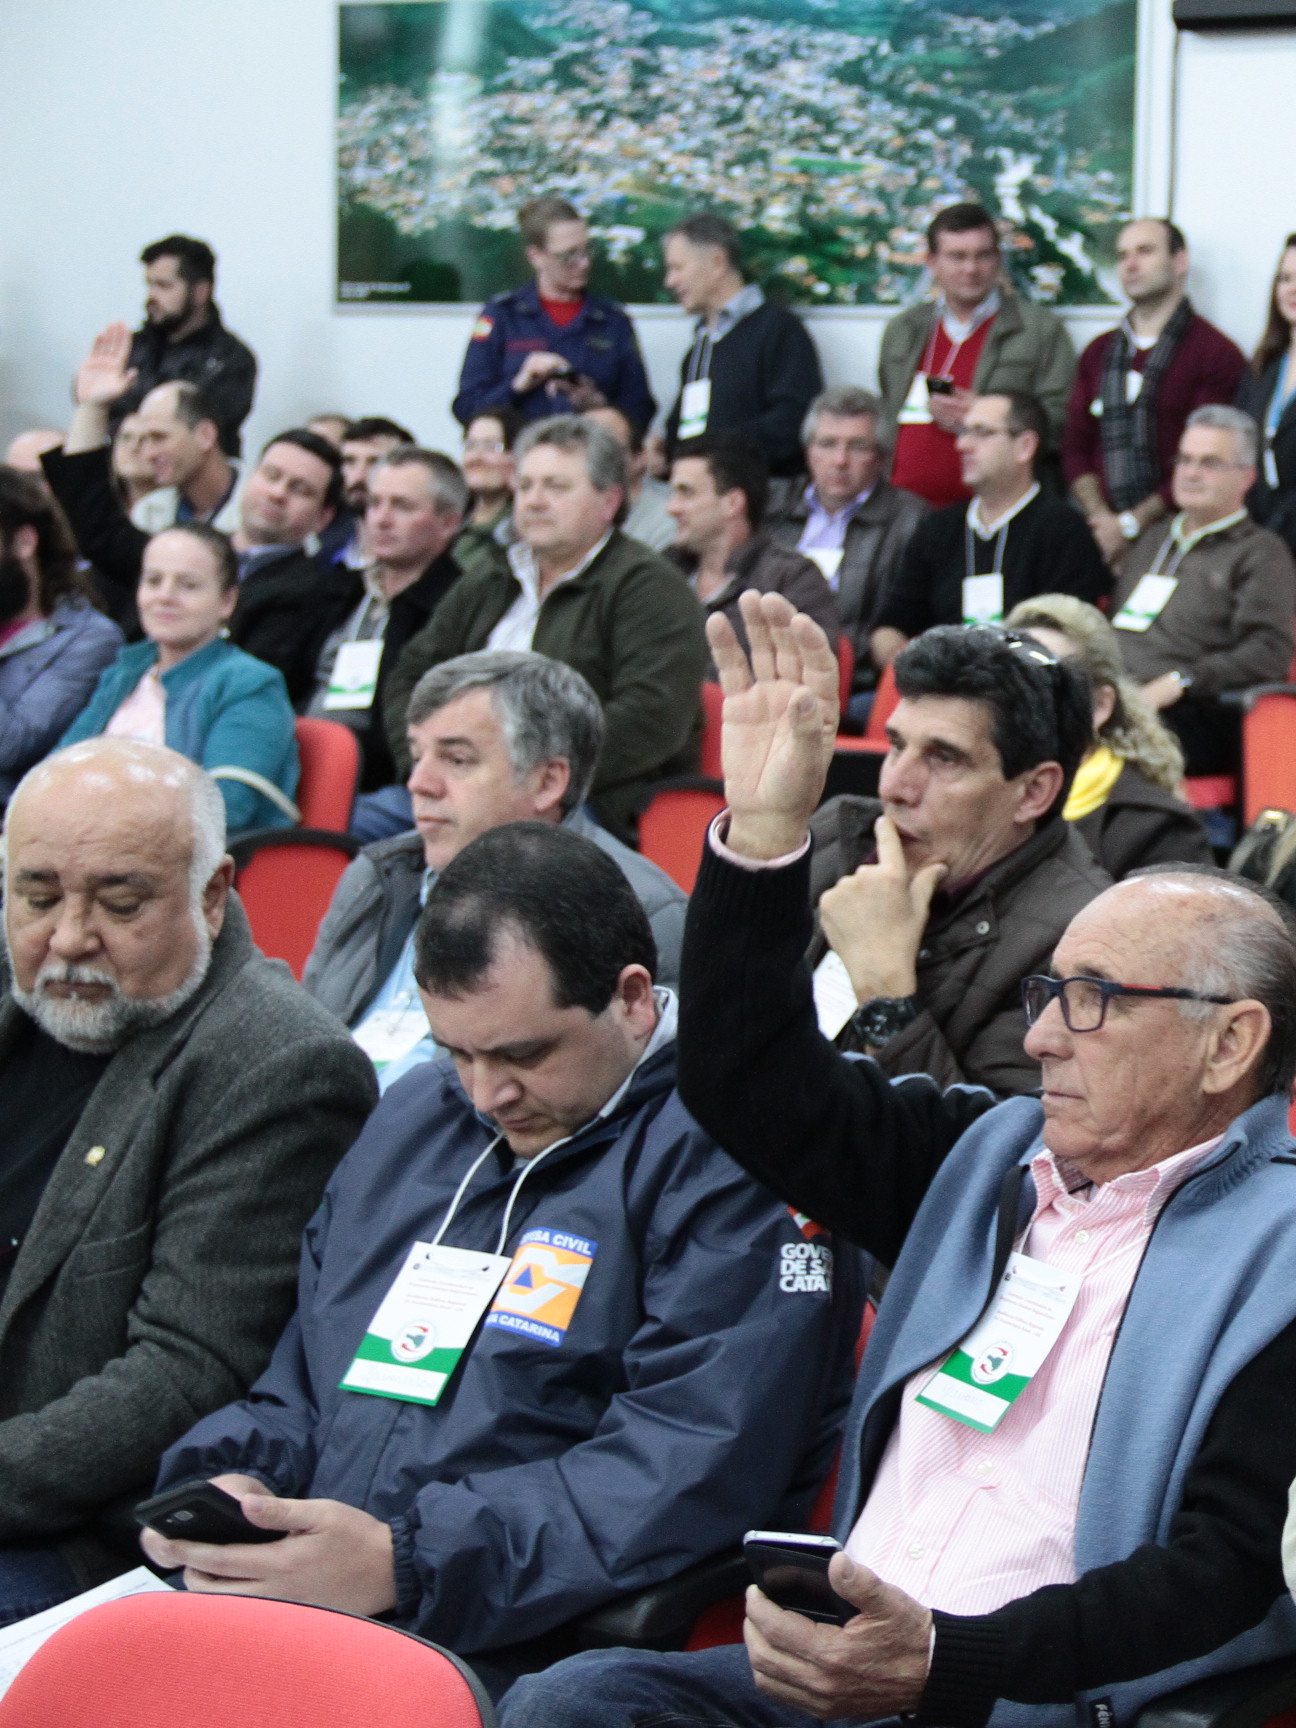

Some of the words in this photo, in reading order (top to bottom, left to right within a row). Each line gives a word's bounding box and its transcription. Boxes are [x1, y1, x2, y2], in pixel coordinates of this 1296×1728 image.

[553, 1234, 592, 1256] CIVIL
[781, 1259, 807, 1275] DE
[499, 1315, 560, 1343] CATARINA
